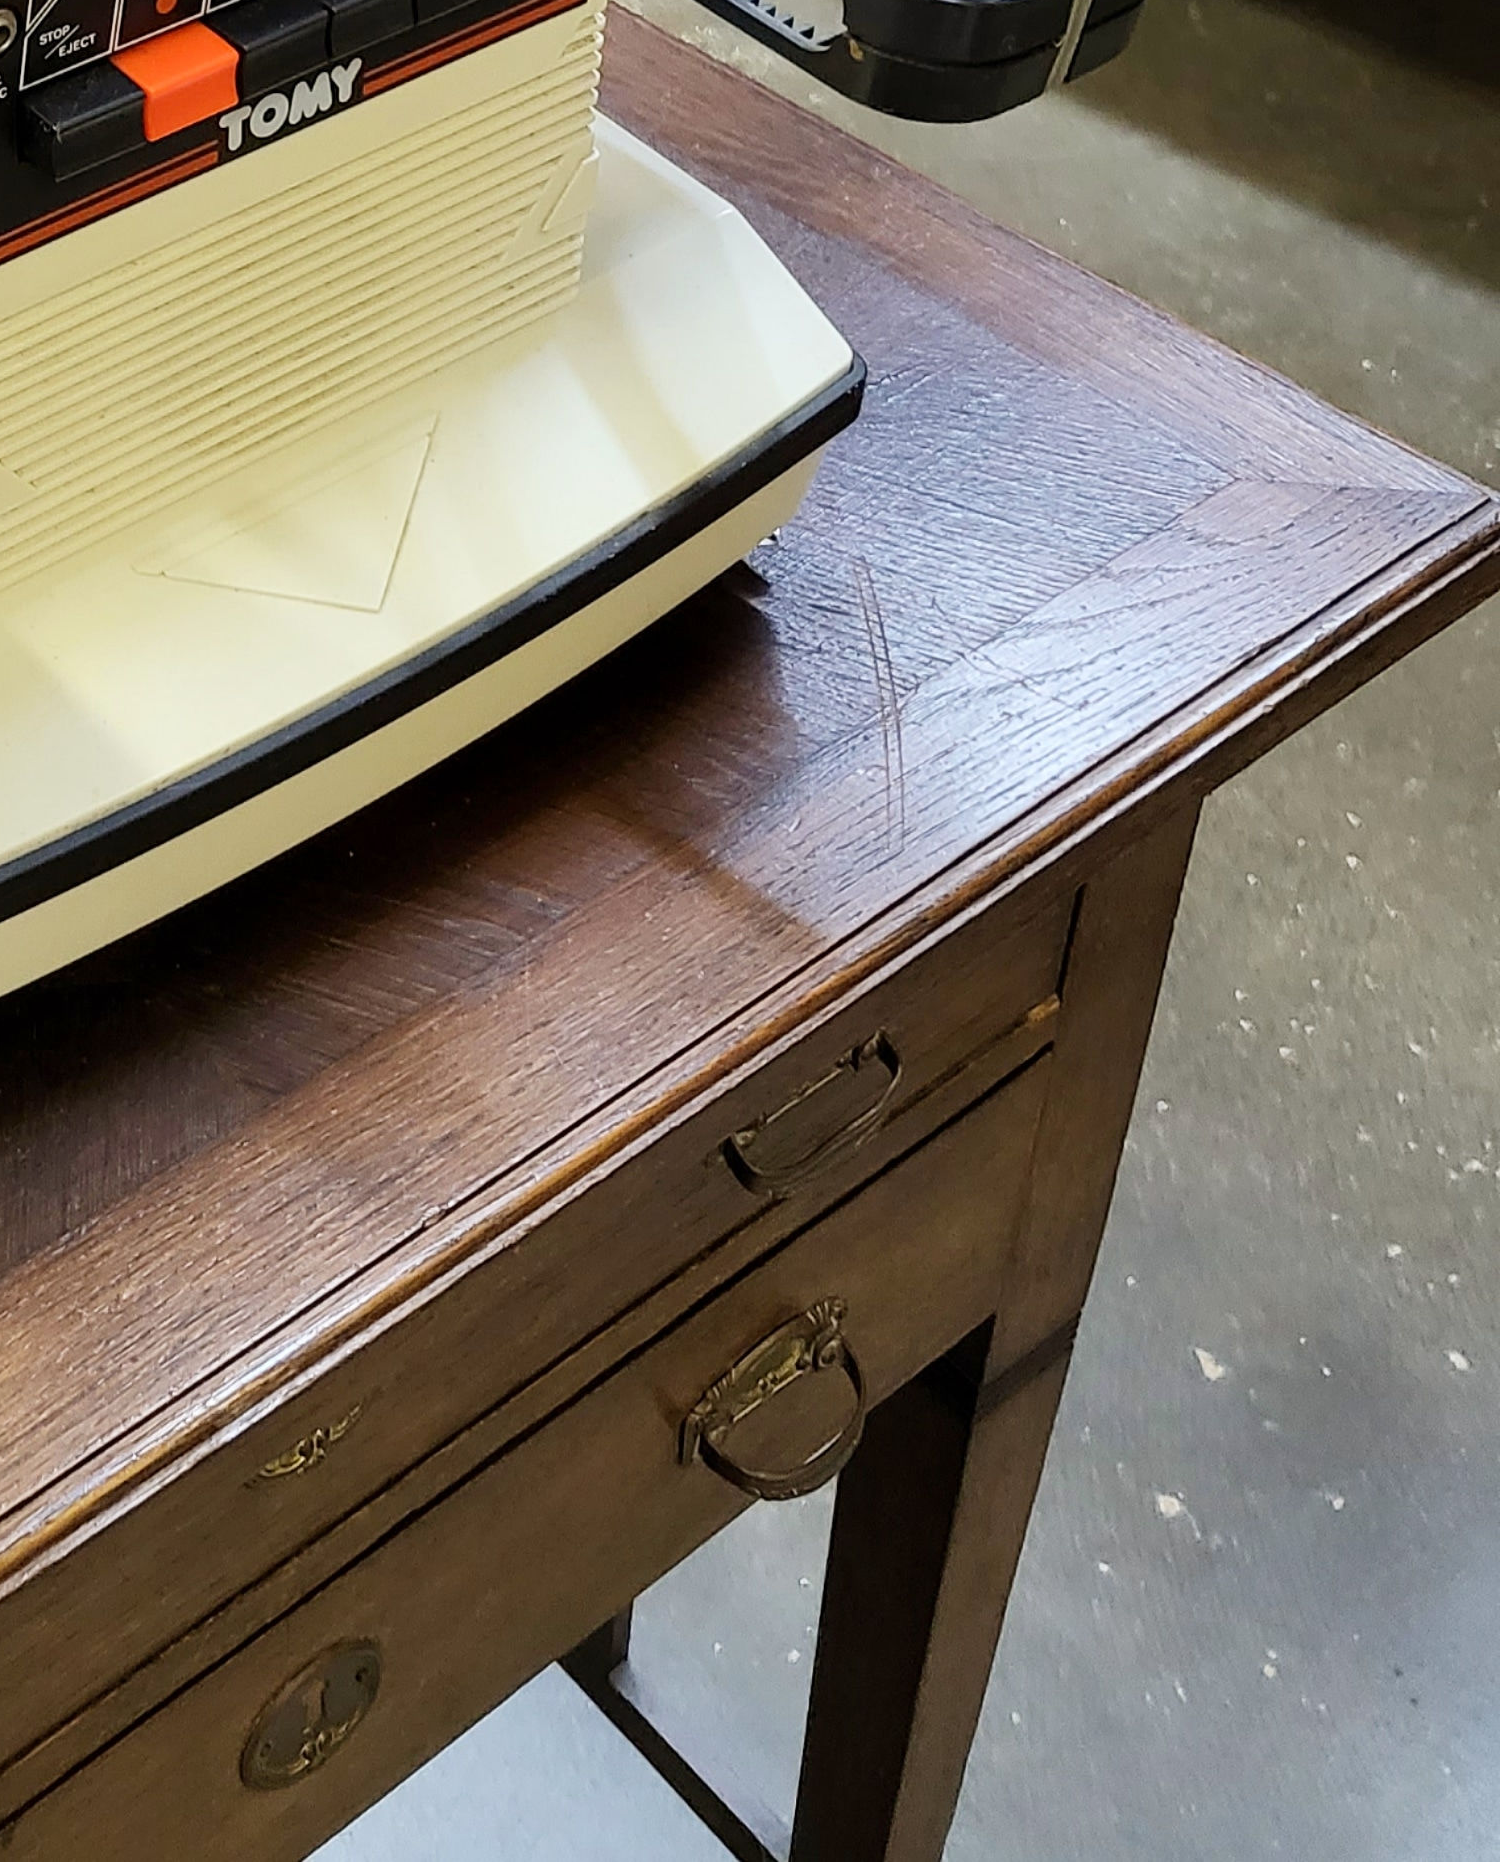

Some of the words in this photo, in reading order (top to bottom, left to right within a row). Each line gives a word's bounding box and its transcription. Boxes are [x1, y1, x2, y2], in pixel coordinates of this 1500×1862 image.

[39, 24, 70, 45] STOP
[58, 33, 97, 57] EJECT
[219, 58, 362, 151] TOMY
